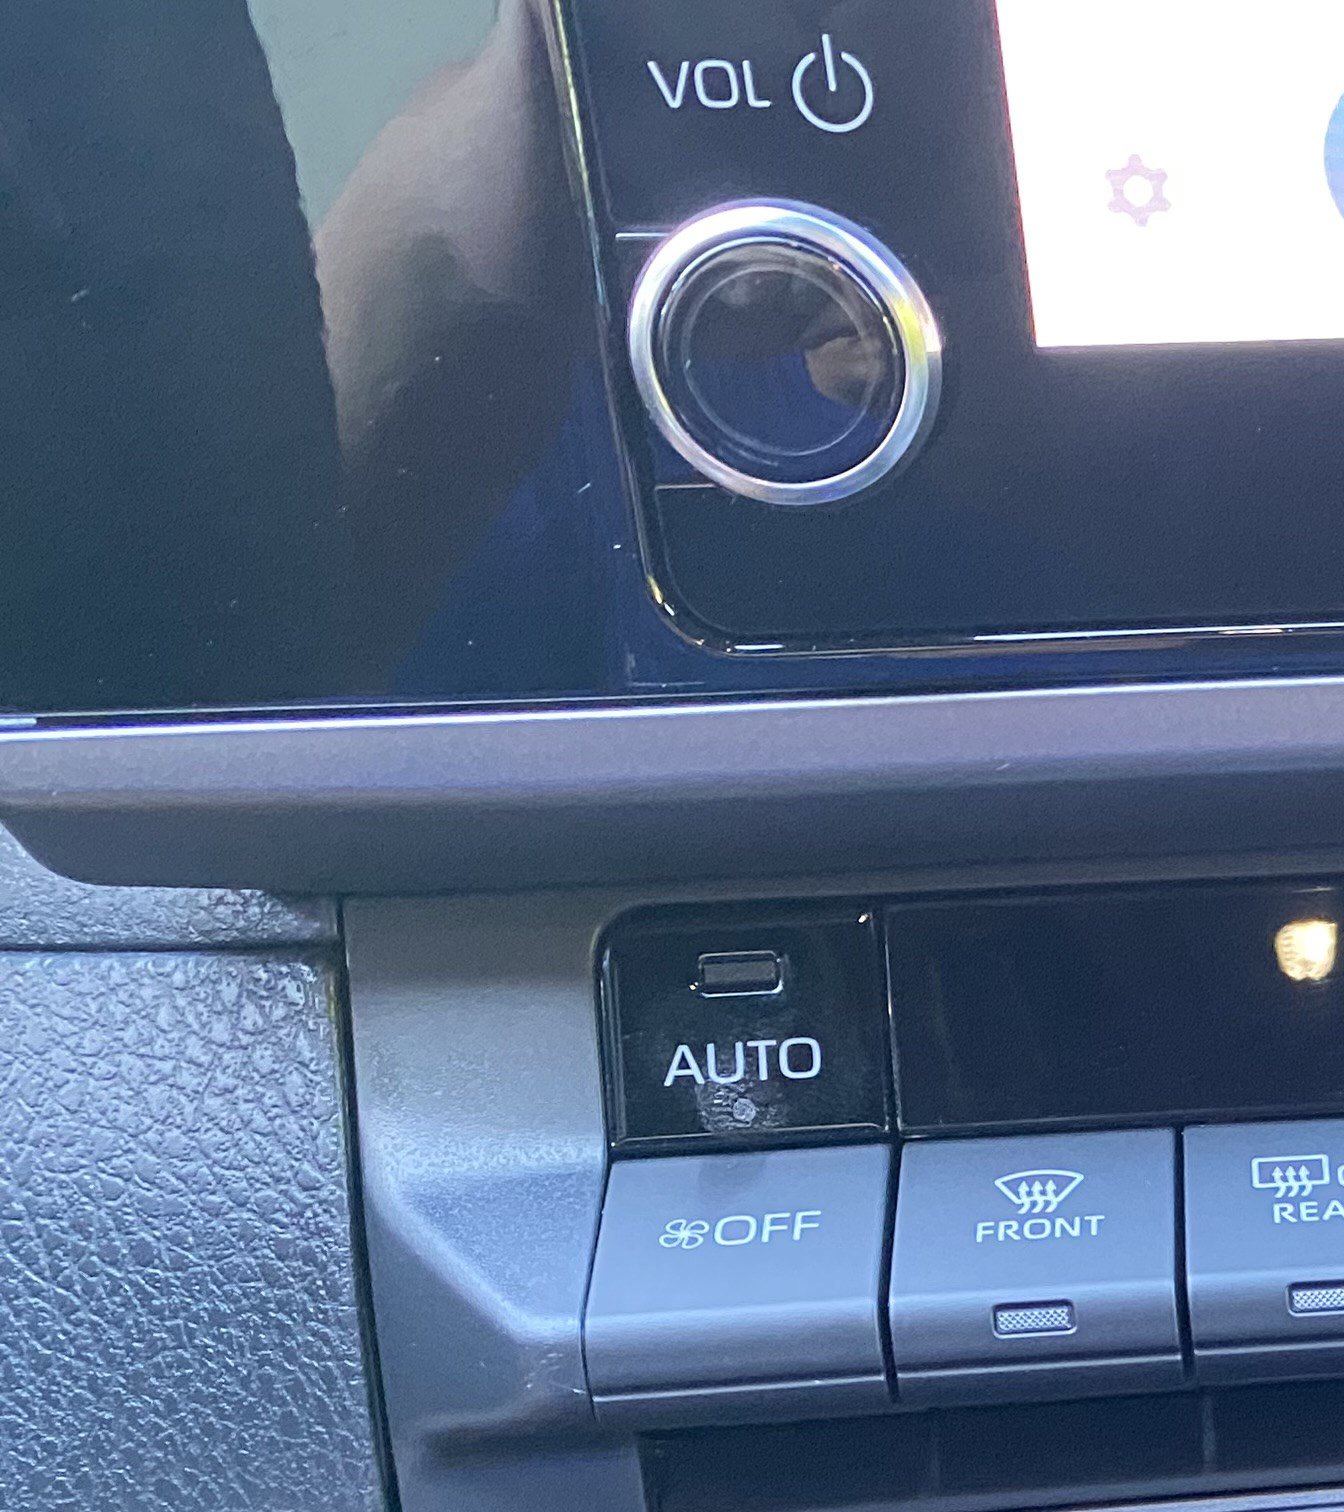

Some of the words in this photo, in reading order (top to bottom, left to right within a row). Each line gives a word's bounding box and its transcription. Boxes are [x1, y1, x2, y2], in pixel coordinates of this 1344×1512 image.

[647, 59, 771, 108] VOL
[662, 1036, 823, 1088] AUTO
[713, 1211, 822, 1247] OFF
[975, 1214, 1106, 1244] FRONT
